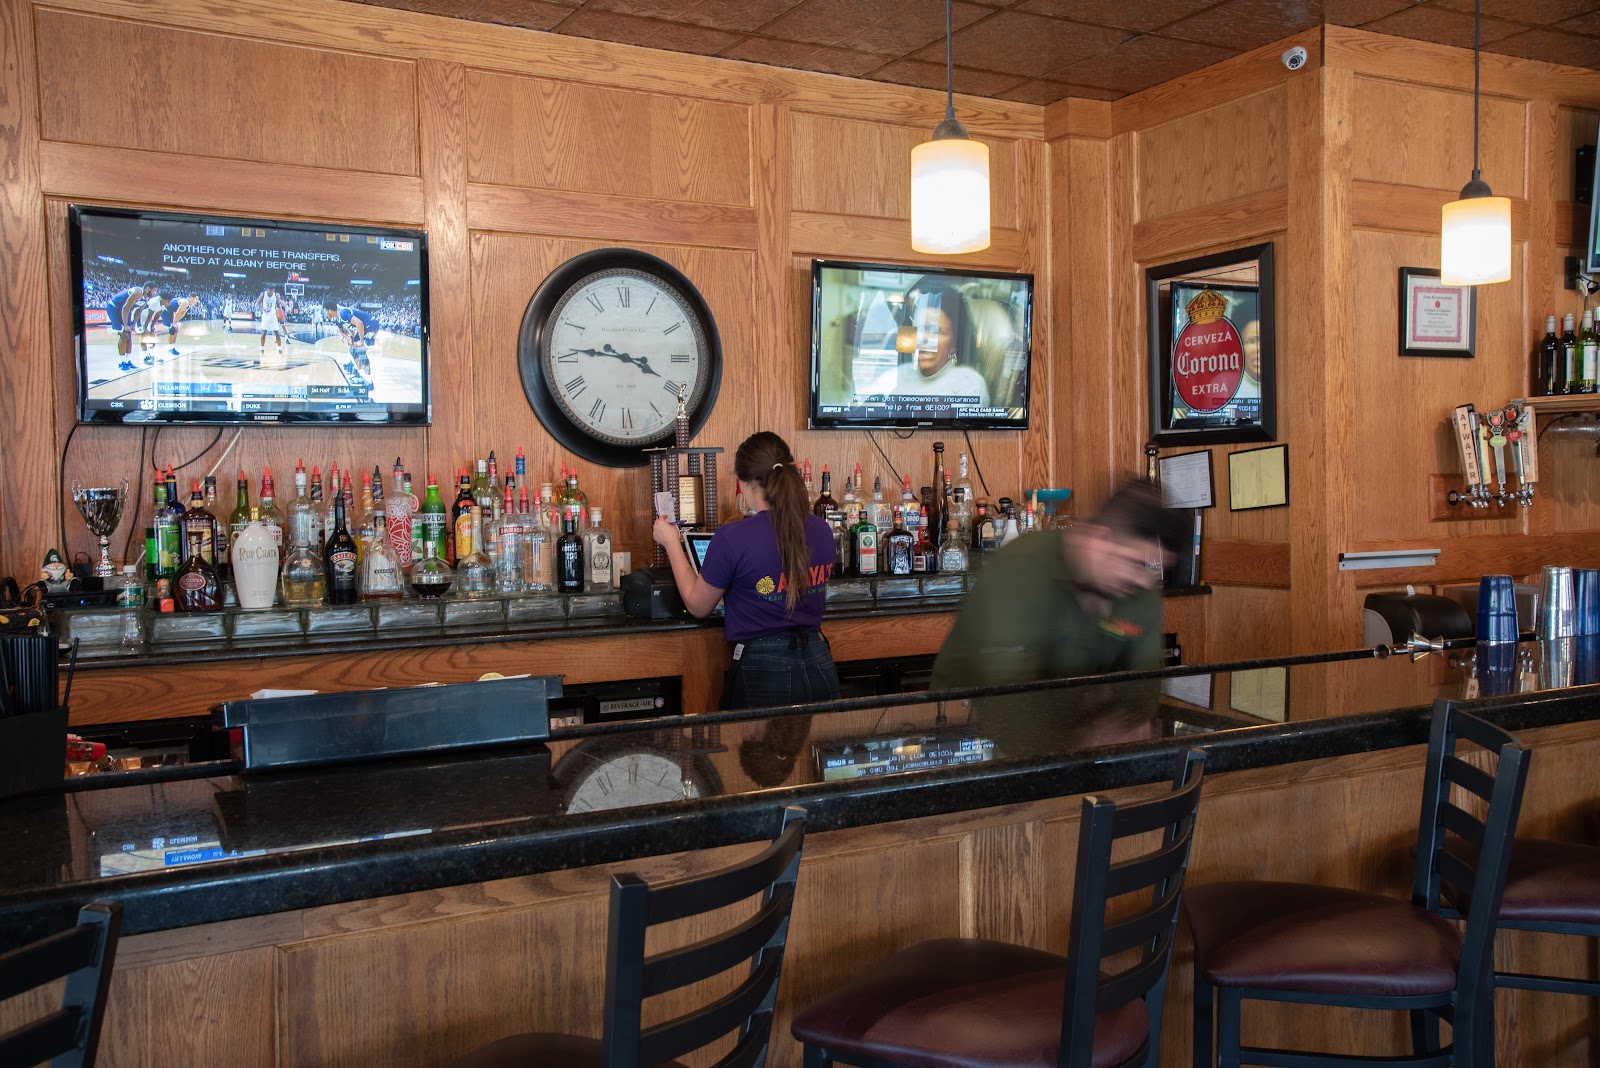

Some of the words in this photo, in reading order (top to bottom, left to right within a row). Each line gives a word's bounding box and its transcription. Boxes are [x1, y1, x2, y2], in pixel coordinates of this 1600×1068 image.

[163, 243, 215, 254] ANOTHER
[216, 247, 240, 256] ONE
[242, 248, 257, 257] OF
[259, 250, 279, 259] THE
[281, 250, 342, 262] TRANSFERS.
[163, 255, 205, 265] PLAYED
[208, 257, 221, 266] AT
[223, 258, 263, 268] ALBANY
[266, 261, 307, 271] BEFORE
[616, 286, 633, 308] XII
[1184, 331, 1232, 347] CERVEZA
[1176, 351, 1240, 379] Corona
[158, 384, 190, 392] VILLANOVA
[217, 385, 227, 393] 31
[1191, 382, 1228, 396] EXTRA
[882, 395, 895, 403] get
[943, 395, 979, 403] insurance
[1460, 414, 1476, 478] ATWATER
[423, 514, 446, 522] SVEDK
[610, 700, 651, 709] BEVERAGE-AIR
